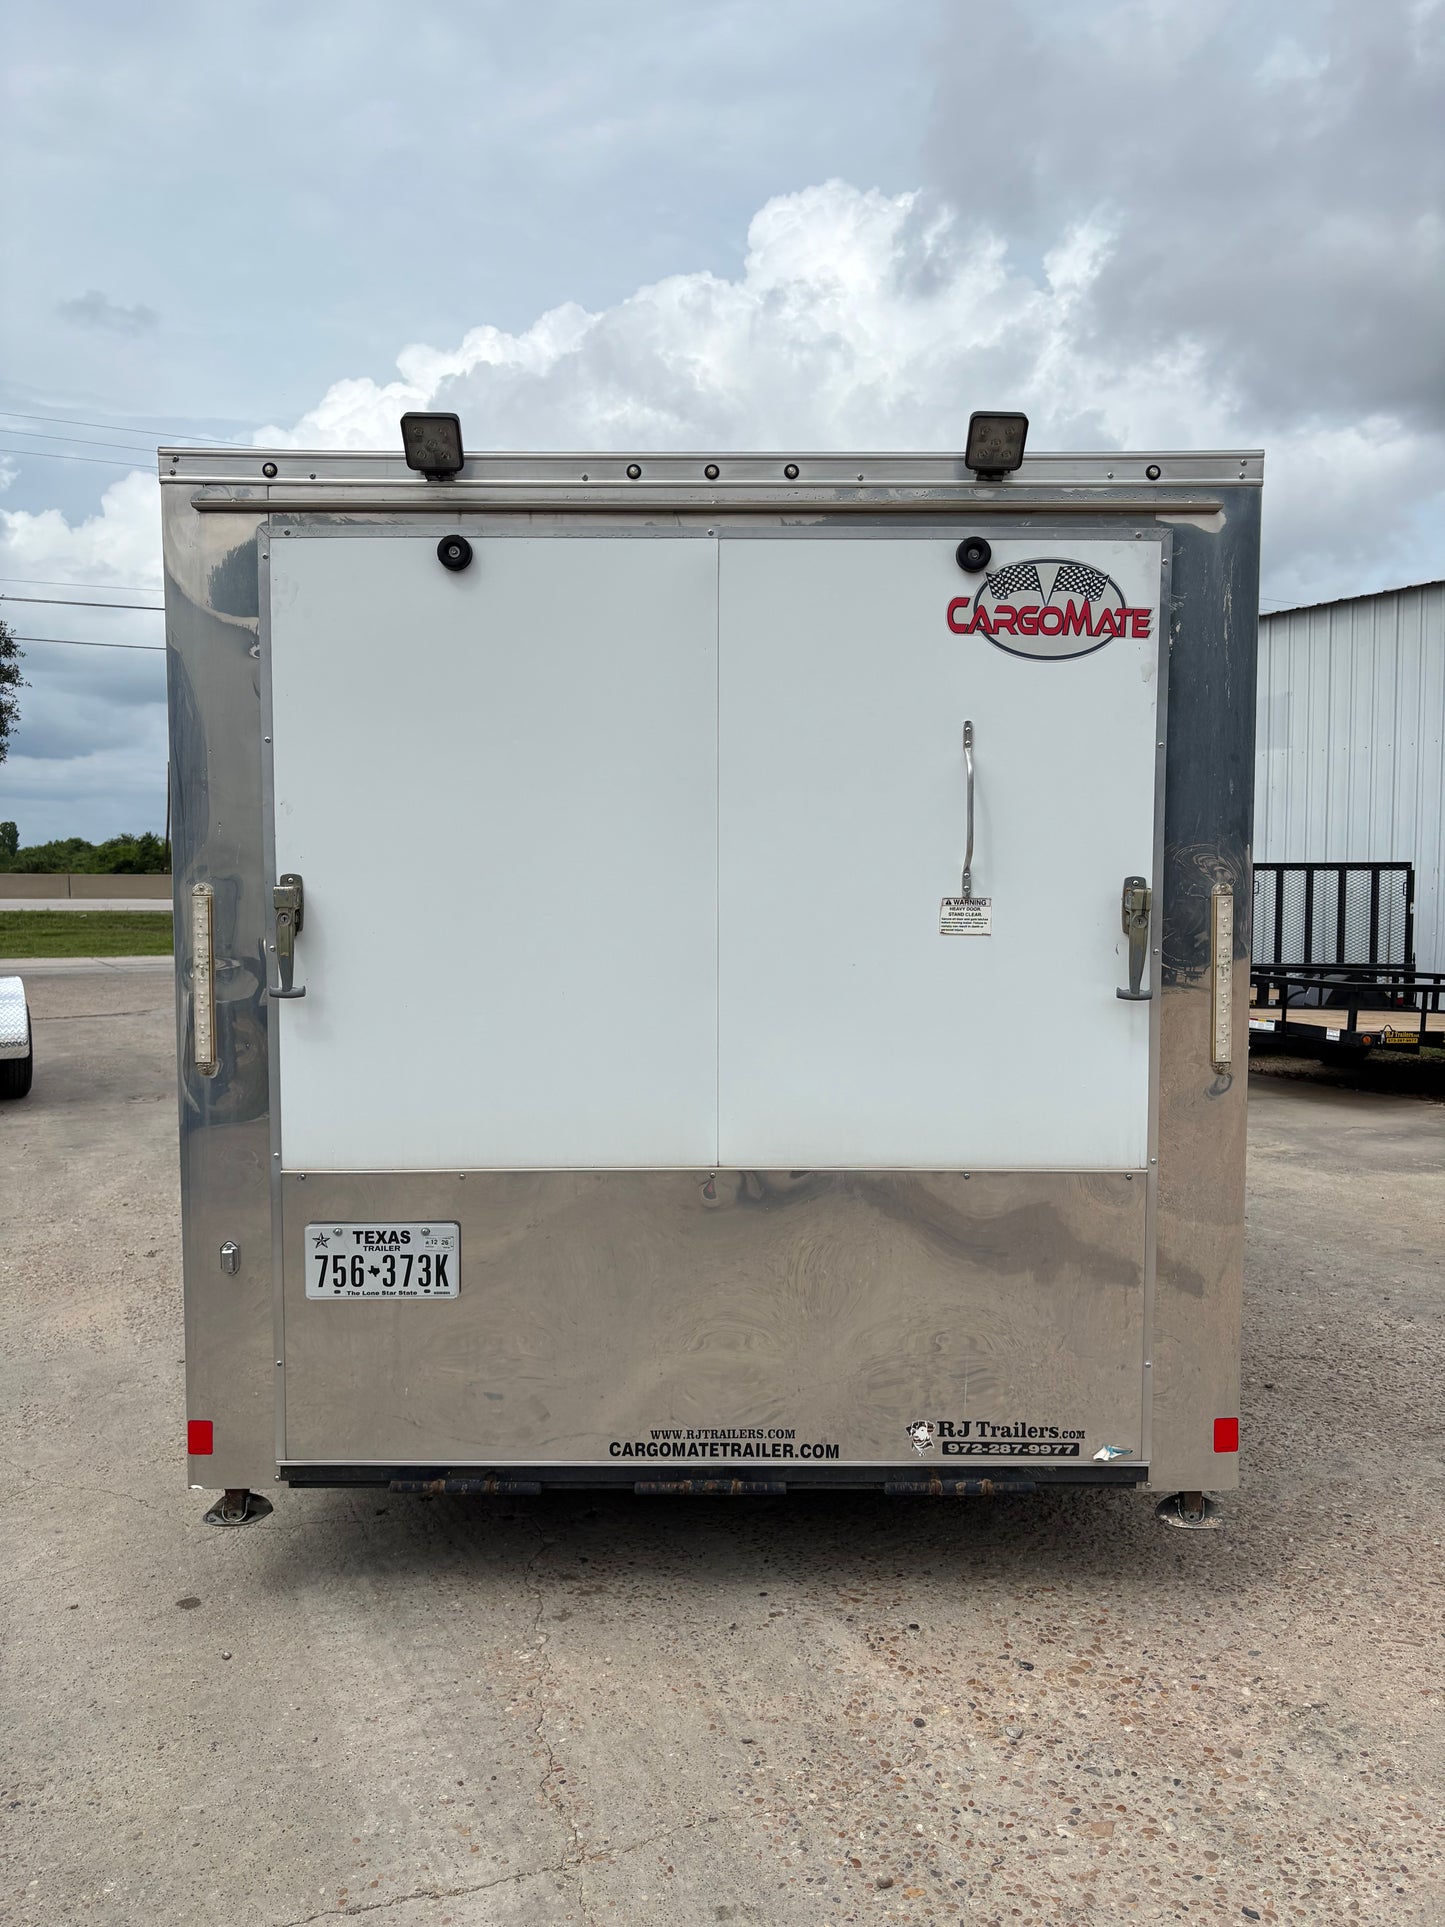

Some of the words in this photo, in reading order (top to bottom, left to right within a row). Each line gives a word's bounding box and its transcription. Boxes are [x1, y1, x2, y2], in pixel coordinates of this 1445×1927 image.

[352, 1230, 411, 1244] TEXAS
[314, 1254, 365, 1288] 756
[382, 1254, 449, 1287] 373K
[650, 1429, 796, 1440] WWW.RJTRAILERS.COM
[937, 1421, 972, 1438] RJ
[609, 1441, 840, 1459] CARGOMATETRAILER.COM
[947, 1443, 1075, 1455] 972-287-9977
